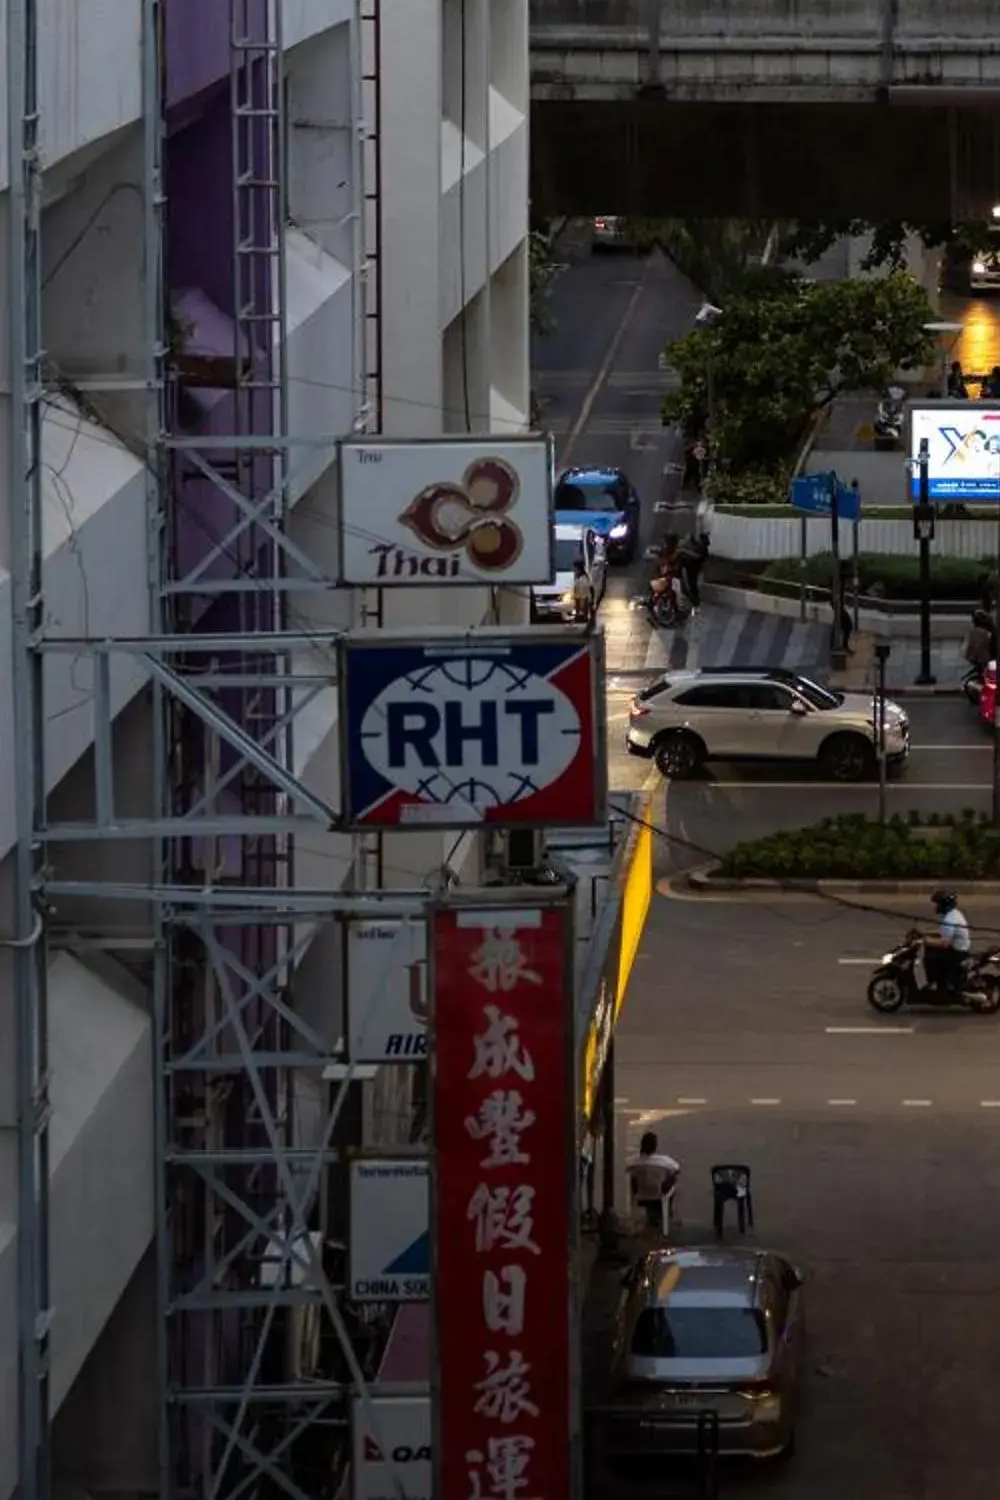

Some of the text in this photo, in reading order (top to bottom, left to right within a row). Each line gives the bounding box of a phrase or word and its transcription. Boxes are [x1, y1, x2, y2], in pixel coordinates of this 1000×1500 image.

[368, 542, 462, 579] Thai
[385, 699, 555, 768] RHT
[355, 1279, 399, 1296] CHINA
